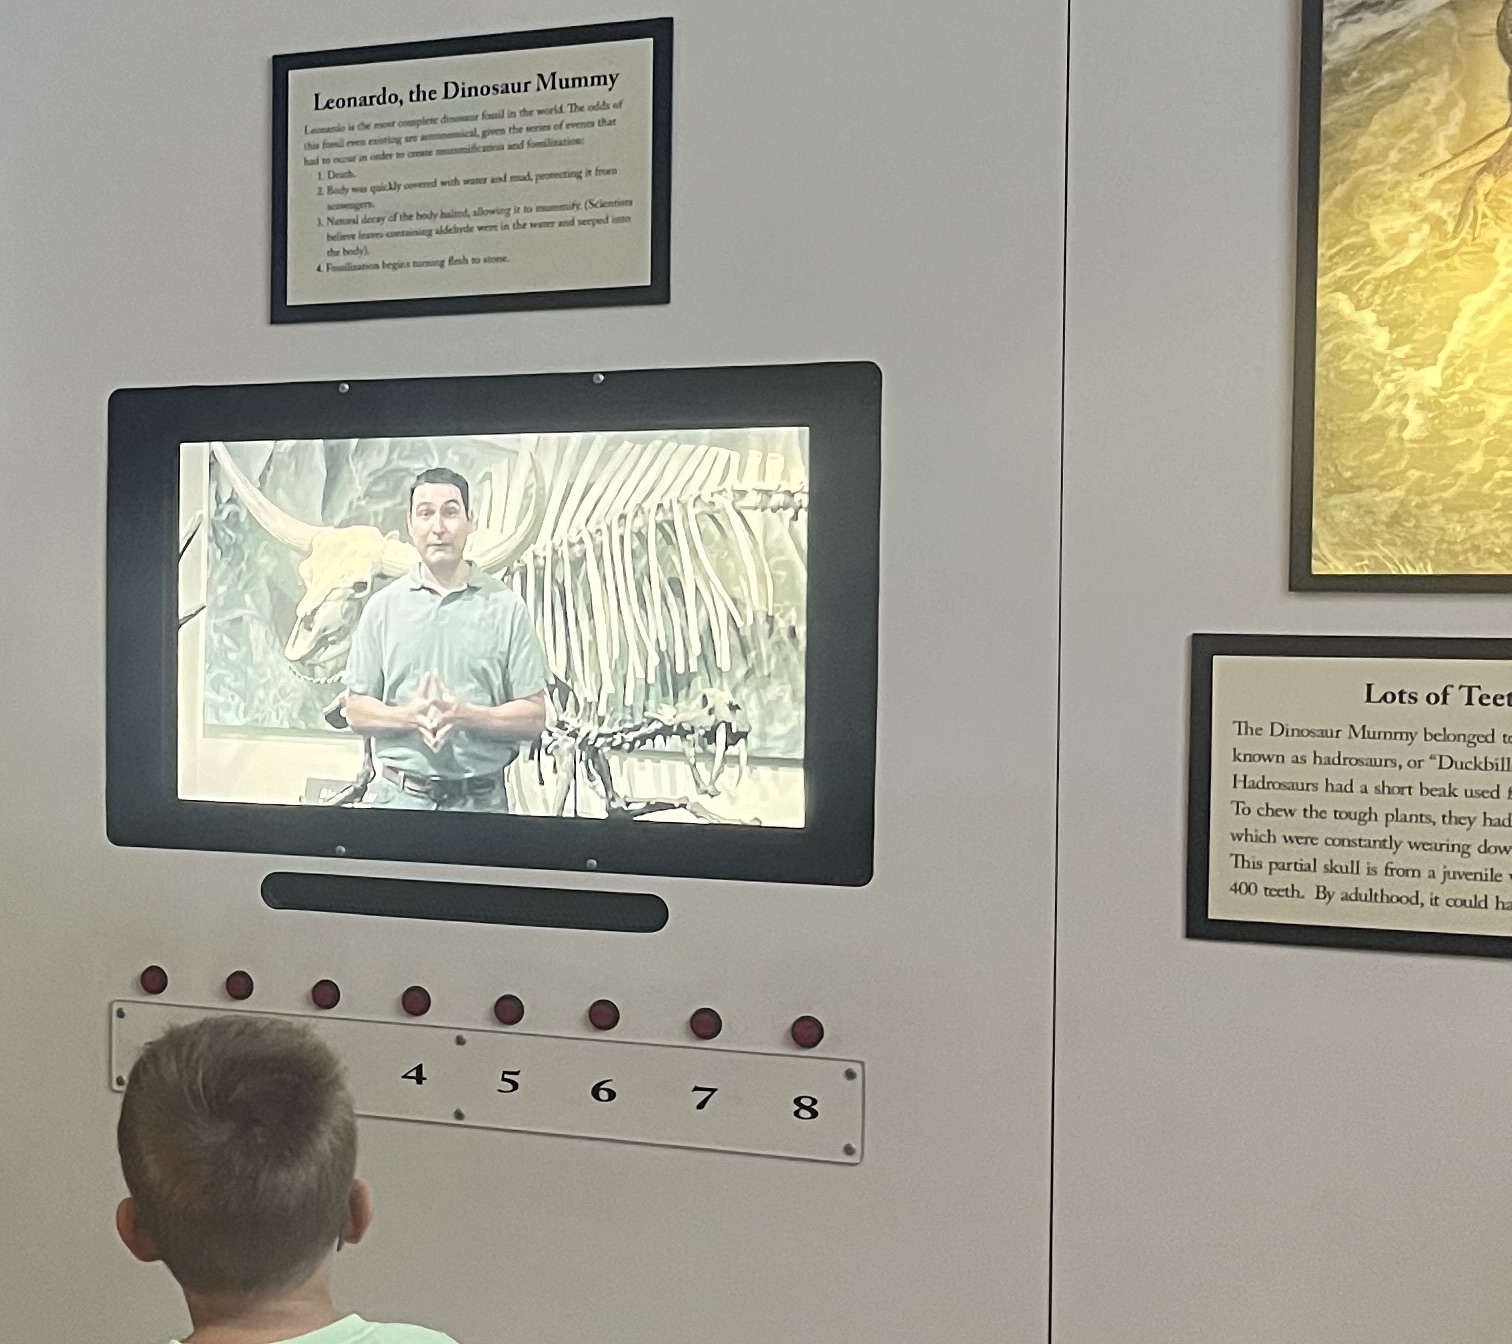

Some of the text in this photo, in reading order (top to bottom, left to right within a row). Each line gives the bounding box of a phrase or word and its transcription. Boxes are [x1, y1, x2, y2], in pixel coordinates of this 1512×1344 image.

[314, 72, 620, 111] Leonardo, the Dinosaur Mummy
[1364, 683, 1418, 704] Lots
[1426, 684, 1454, 705] of
[1232, 720, 1263, 736] The
[1270, 722, 1342, 738] Dinosaur
[1347, 724, 1418, 746] Mummy
[1424, 727, 1495, 748] belonged
[1232, 748, 1285, 763] known
[1291, 754, 1307, 765] as
[1313, 750, 1403, 771] hadrosaurs,
[1407, 758, 1424, 768] or
[1232, 774, 1319, 792] Hadrosaurs
[1325, 778, 1354, 793] had
[1360, 784, 1368, 794] a
[1374, 780, 1413, 796] short
[1420, 782, 1458, 797] beak
[1464, 784, 1500, 799] used
[1231, 801, 1512, 831] To chew the tough plants, they had
[1230, 828, 1276, 844] which
[1283, 832, 1319, 846] were
[1324, 835, 1403, 855] constantly
[1408, 838, 1472, 858] wearing
[1230, 853, 1262, 870] This
[1268, 858, 1317, 875] partial
[1323, 859, 1360, 875] skull
[1366, 862, 1377, 876] is
[1384, 861, 1421, 878] from
[1428, 870, 1436, 879] a
[1440, 865, 1503, 885] juvenile
[1229, 881, 1257, 896] 400
[1264, 885, 1305, 899] teeth.
[1315, 885, 1335, 905] By
[1341, 887, 1424, 908] adulthood,
[1430, 892, 1440, 907] it
[1446, 894, 1488, 909] could
[400, 1063, 819, 1120] 4 5 6 7 8
